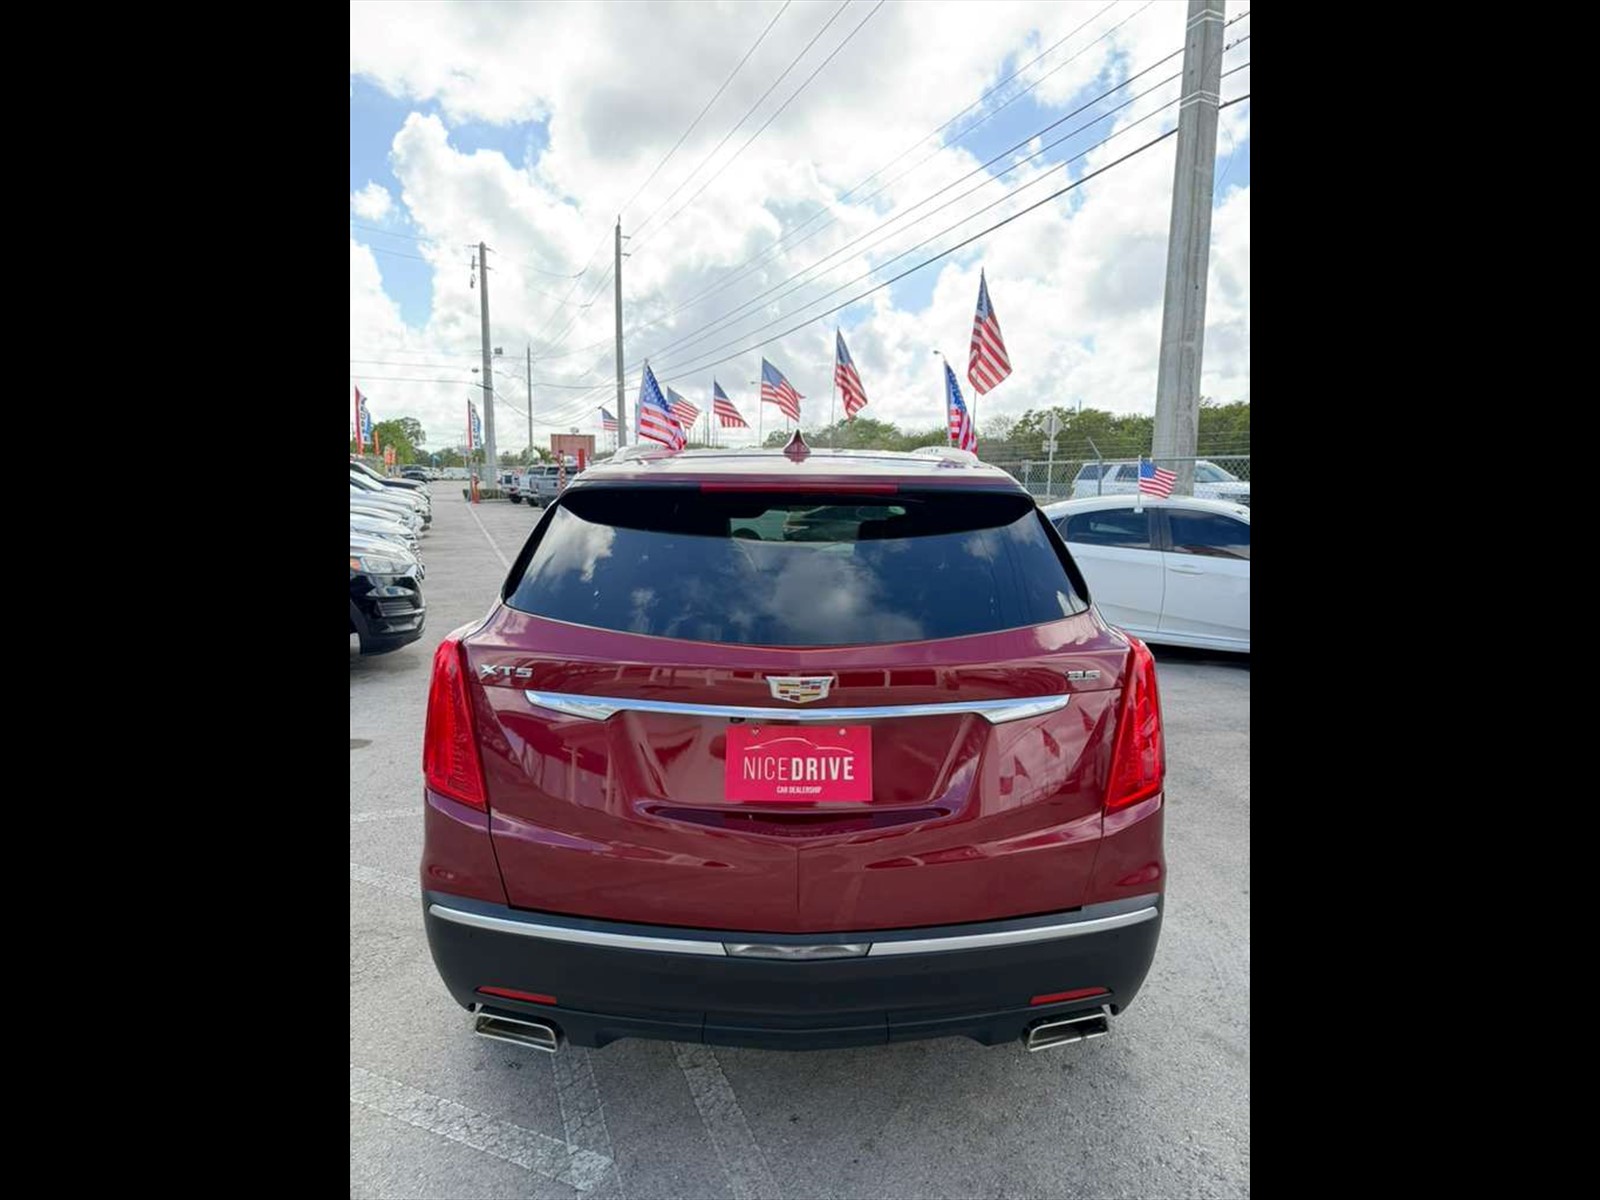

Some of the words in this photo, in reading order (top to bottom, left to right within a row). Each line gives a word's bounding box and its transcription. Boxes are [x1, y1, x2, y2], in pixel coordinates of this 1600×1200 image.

[480, 664, 533, 677] XT5
[776, 786, 789, 794] CAR
[789, 786, 822, 794] DEALERSHIP
